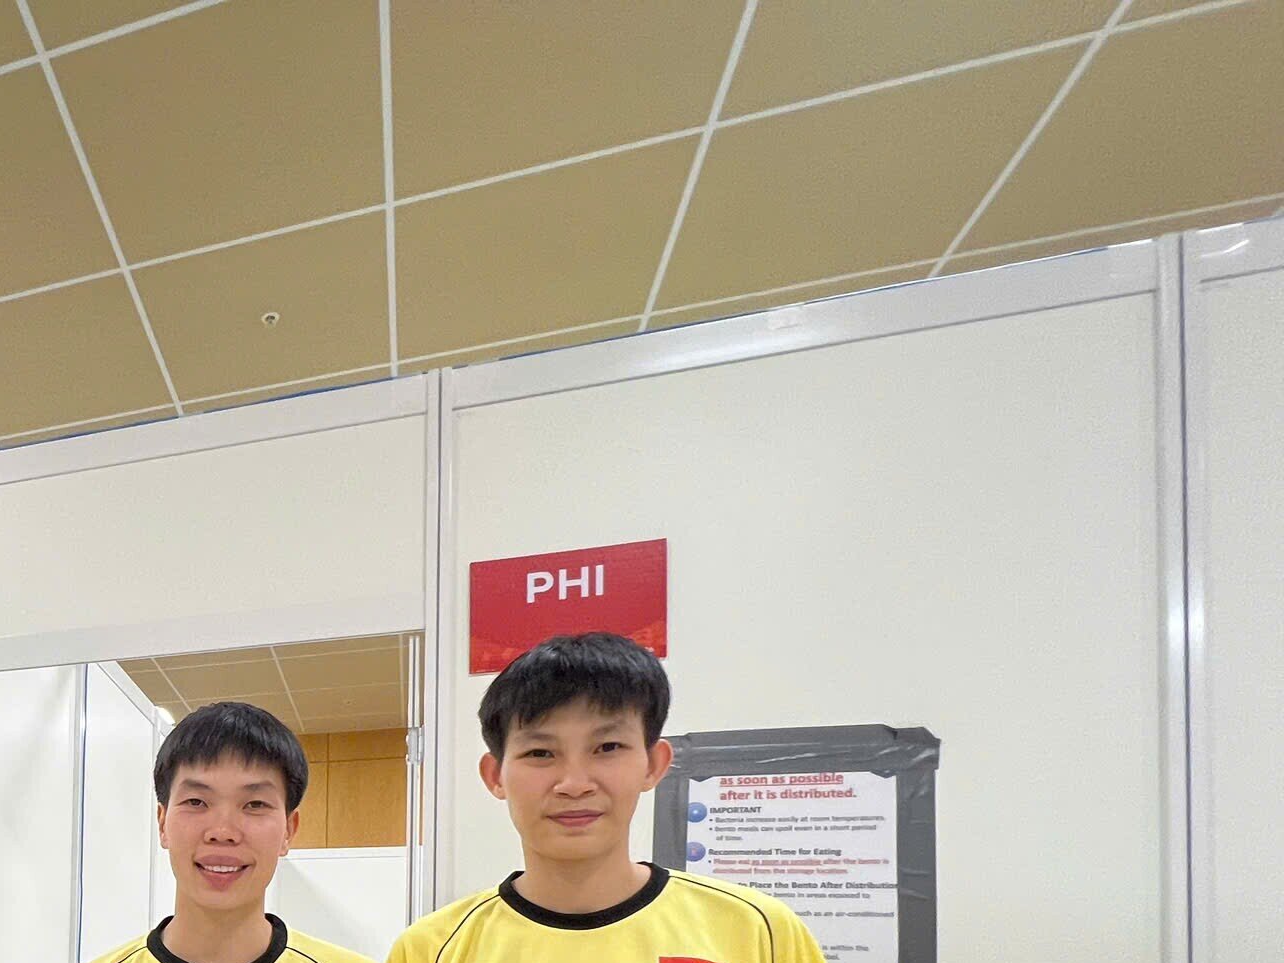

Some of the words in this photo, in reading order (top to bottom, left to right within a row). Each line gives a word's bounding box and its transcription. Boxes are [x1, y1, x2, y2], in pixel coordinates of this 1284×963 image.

[526, 564, 604, 604] PHI
[719, 777, 734, 785] as
[737, 776, 767, 785] soon
[771, 775, 786, 784] as
[789, 772, 844, 785] possible
[719, 790, 751, 801] after
[754, 789, 764, 799] it
[766, 789, 777, 799] is
[780, 787, 857, 799] distributed.
[709, 806, 762, 814] IMPORTANT
[708, 848, 773, 856] Recommended
[798, 847, 811, 855] for
[813, 848, 842, 857] Eating
[749, 881, 772, 889] Place
[774, 881, 789, 889] the
[791, 881, 818, 889] Bento
[820, 881, 843, 889] After
